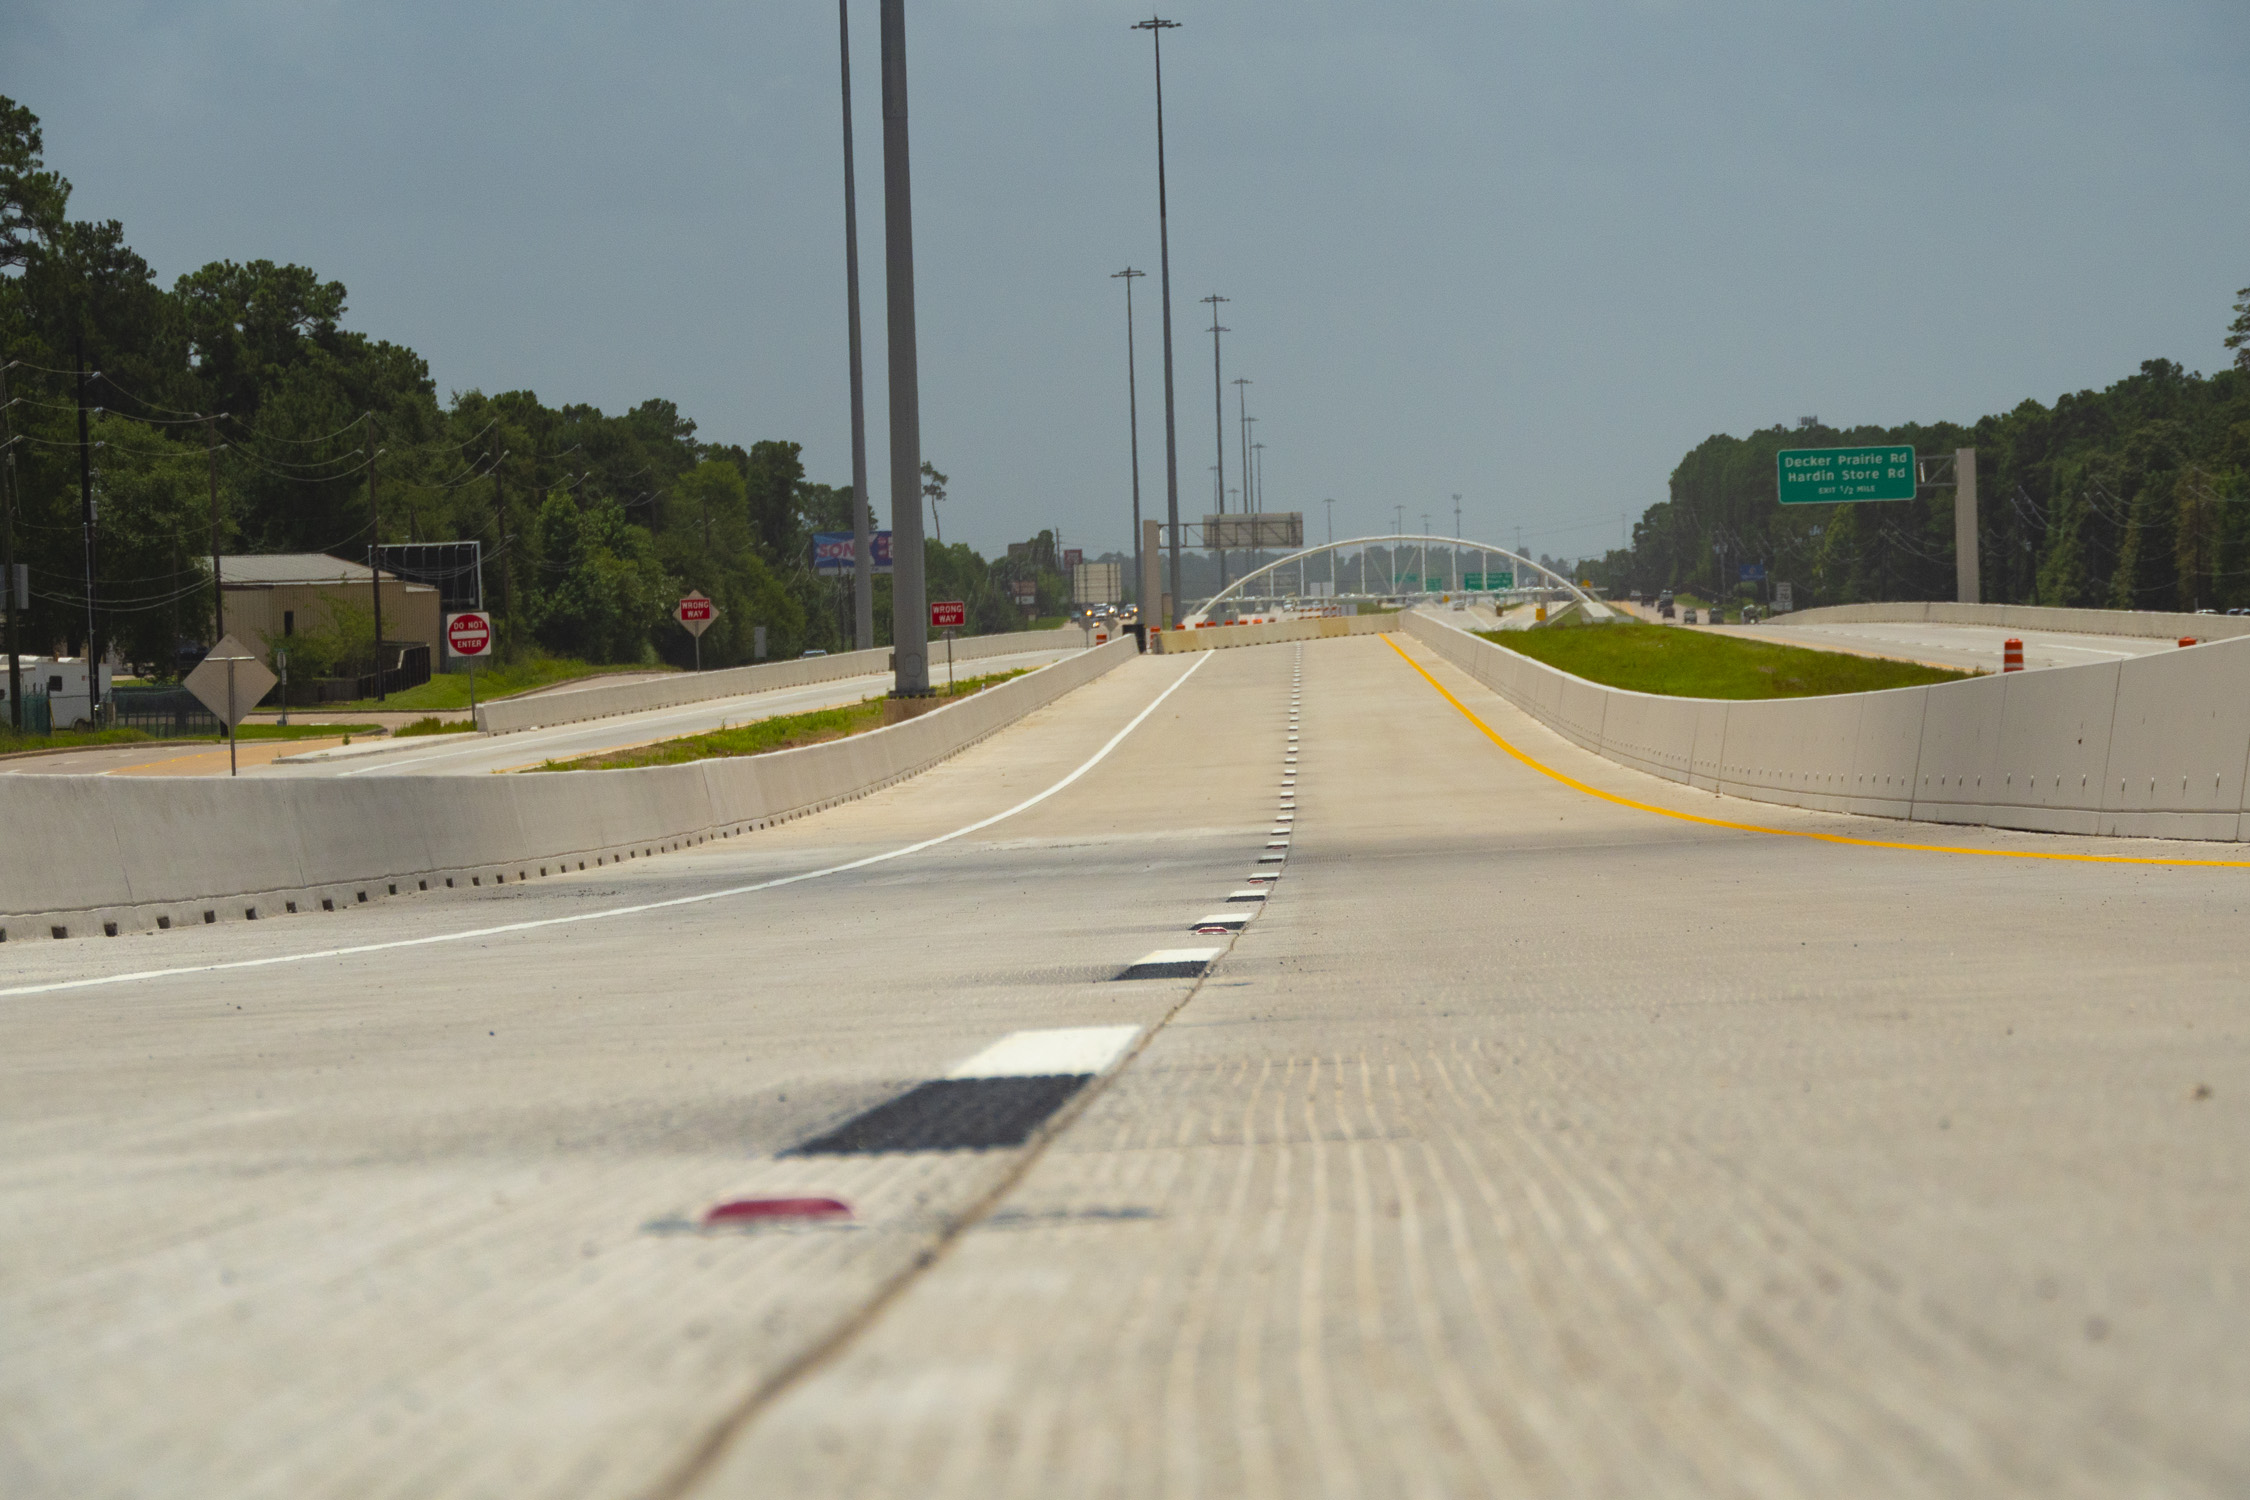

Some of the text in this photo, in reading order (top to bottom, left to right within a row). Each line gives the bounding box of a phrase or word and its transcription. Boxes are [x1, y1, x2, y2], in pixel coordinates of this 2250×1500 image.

[1784, 452, 1907, 468] Decker Prairie Rd
[1787, 467, 1906, 482] Hardin Store Rd
[1818, 486, 1836, 495] EXIT
[1856, 484, 1876, 493] MILE
[681, 601, 709, 610] WRONG
[932, 604, 962, 614] WRONG
[687, 610, 704, 618] WAY
[938, 614, 957, 623] WAY
[453, 621, 483, 630] DO NOT
[457, 640, 482, 648] ENTER
